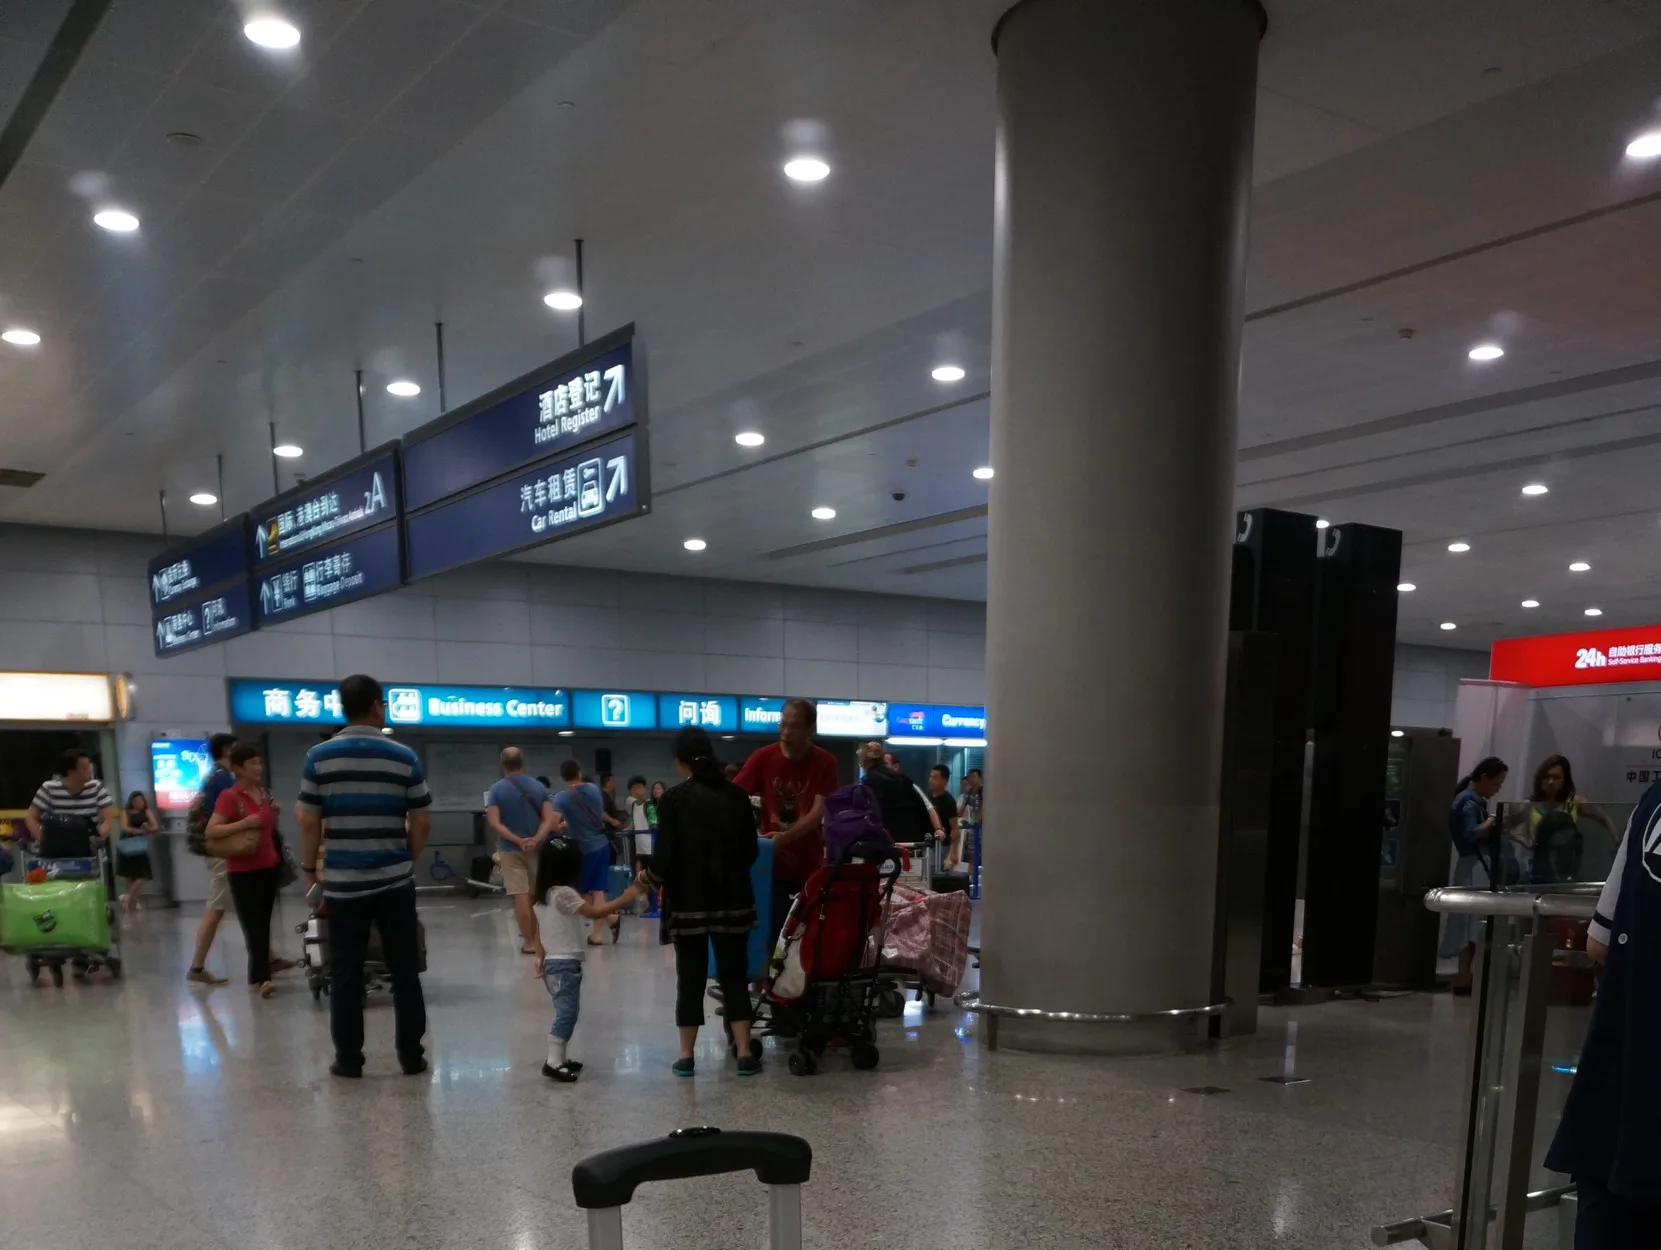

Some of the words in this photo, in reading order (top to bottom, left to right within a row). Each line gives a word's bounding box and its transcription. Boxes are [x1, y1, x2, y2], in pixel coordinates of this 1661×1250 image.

[539, 370, 601, 423] 酒店登记
[535, 419, 559, 444] Hotel
[561, 405, 600, 434] Register
[519, 467, 577, 513] 汽车租赁
[531, 512, 546, 532] Car
[548, 502, 577, 526] Rental
[316, 552, 352, 583] 行李寄存
[1575, 647, 1607, 668] 24h
[1608, 657, 1639, 666] Self-Service
[428, 697, 504, 716] Business
[506, 699, 563, 717] Center
[679, 700, 721, 726] 问讯
[942, 713, 986, 730] Currency
